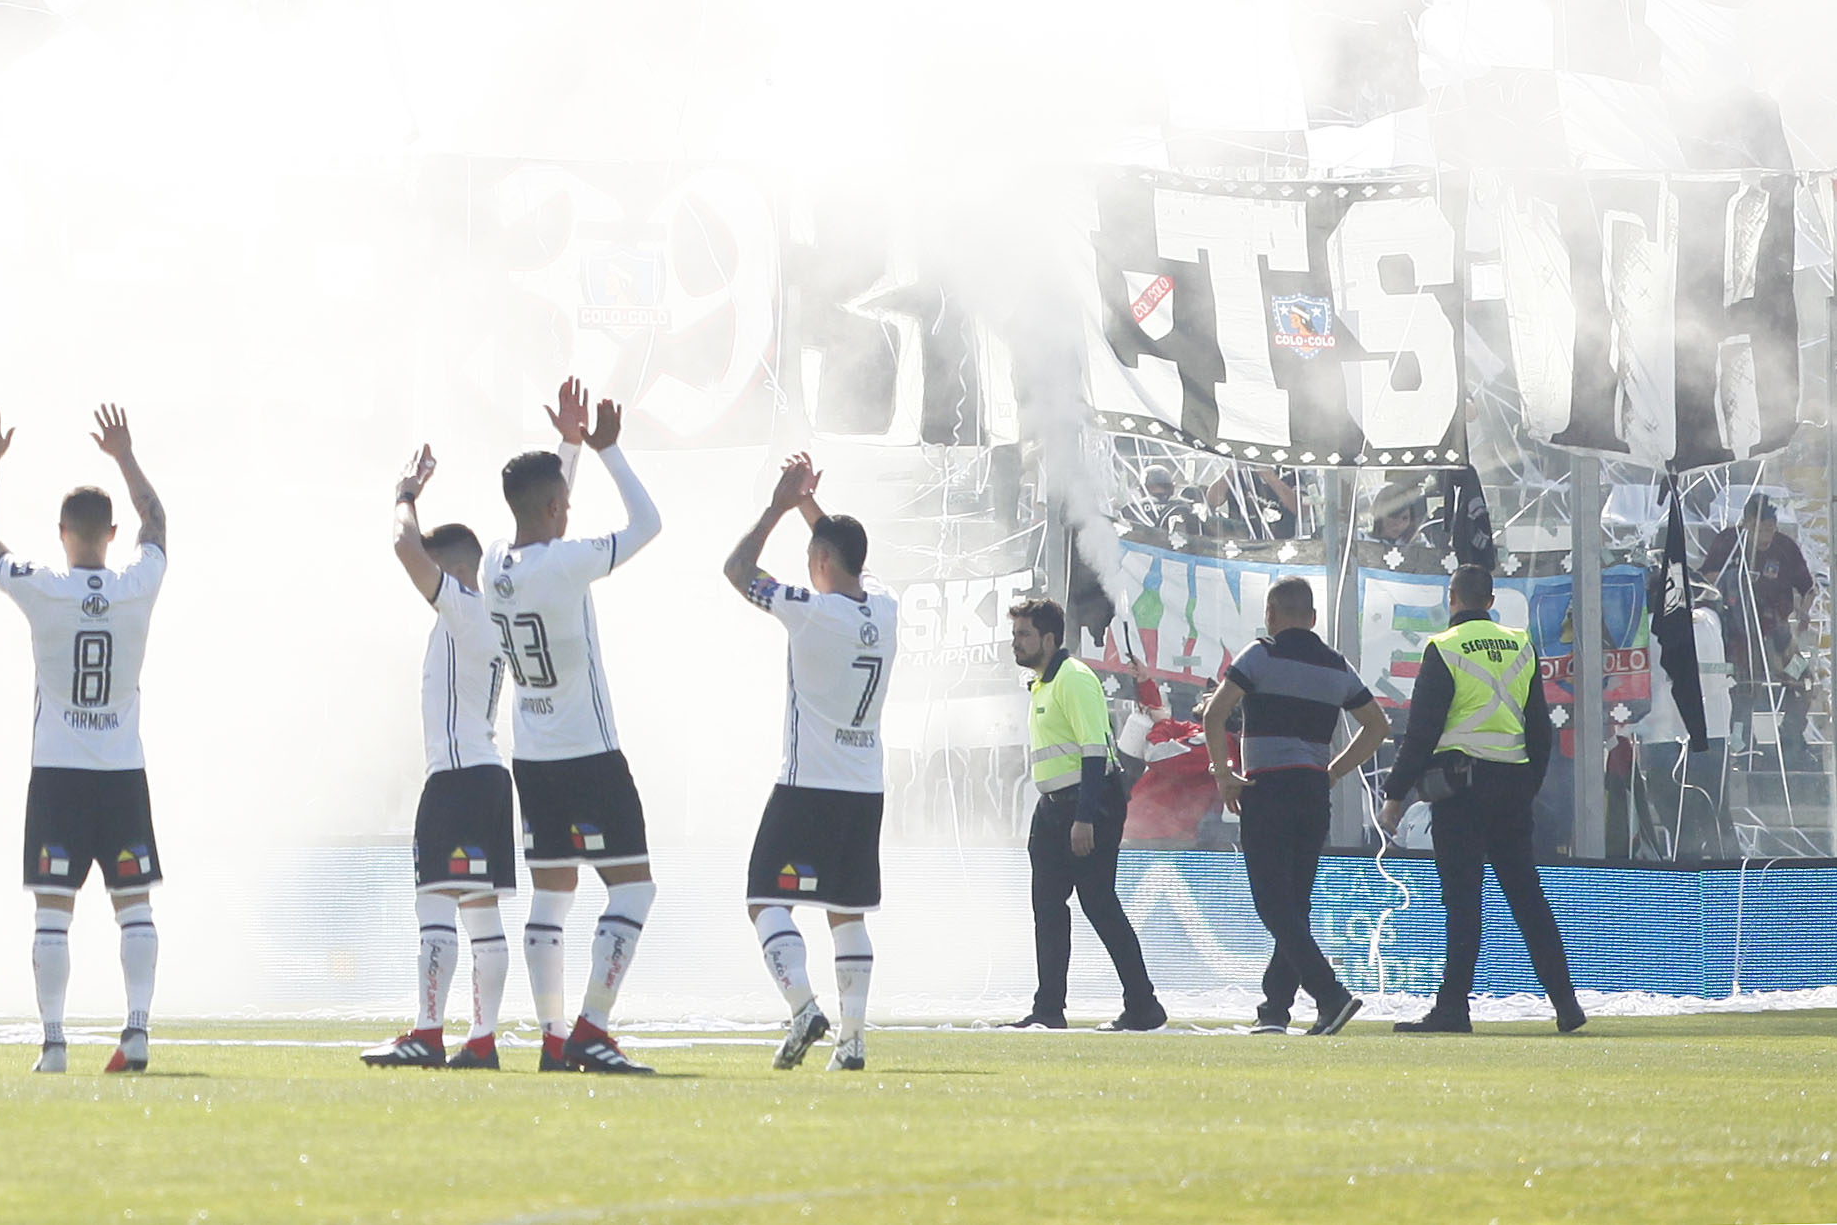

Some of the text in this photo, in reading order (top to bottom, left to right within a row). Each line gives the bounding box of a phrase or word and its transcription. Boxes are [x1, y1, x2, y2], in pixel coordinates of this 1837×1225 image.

[1461, 638, 1519, 654] SEGURIDAD
[72, 630, 113, 708] 8
[851, 656, 883, 728] 7
[64, 711, 119, 730] CARMONA
